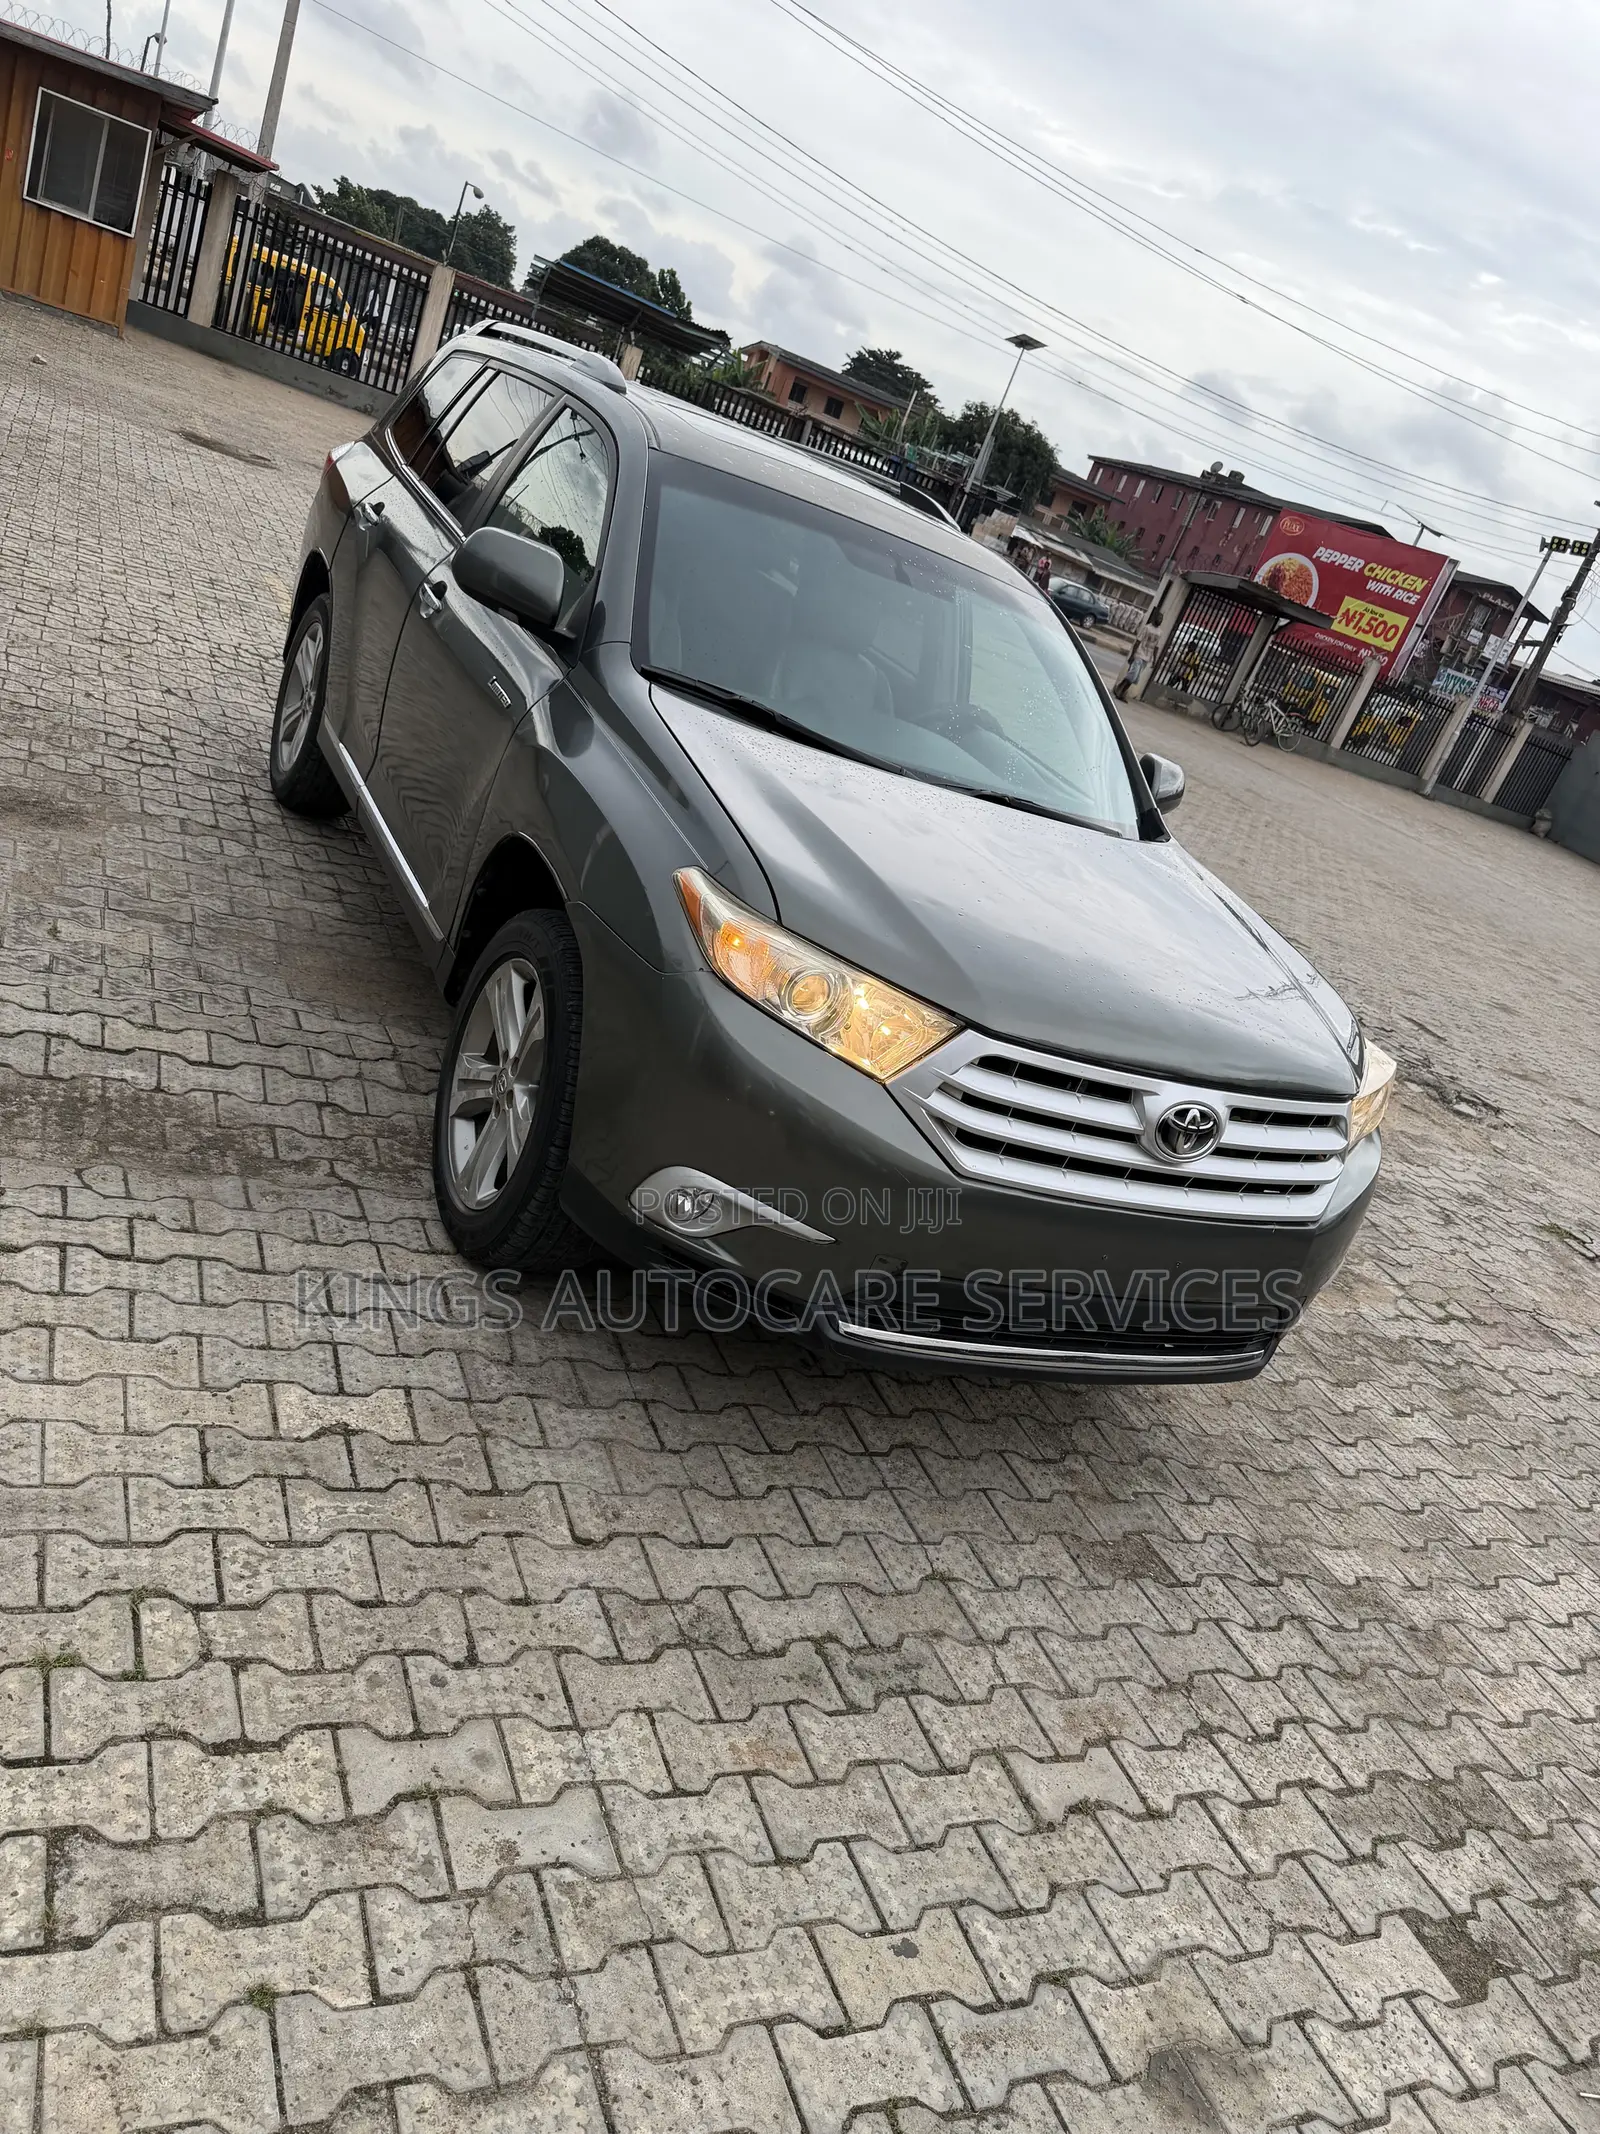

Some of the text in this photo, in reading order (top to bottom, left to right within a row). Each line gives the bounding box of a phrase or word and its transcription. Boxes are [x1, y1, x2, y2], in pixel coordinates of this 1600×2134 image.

[1312, 546, 1428, 593] PEPPER CHICKEN
[1366, 579, 1421, 605] WITH RICE
[1482, 592, 1514, 612] PLAZA
